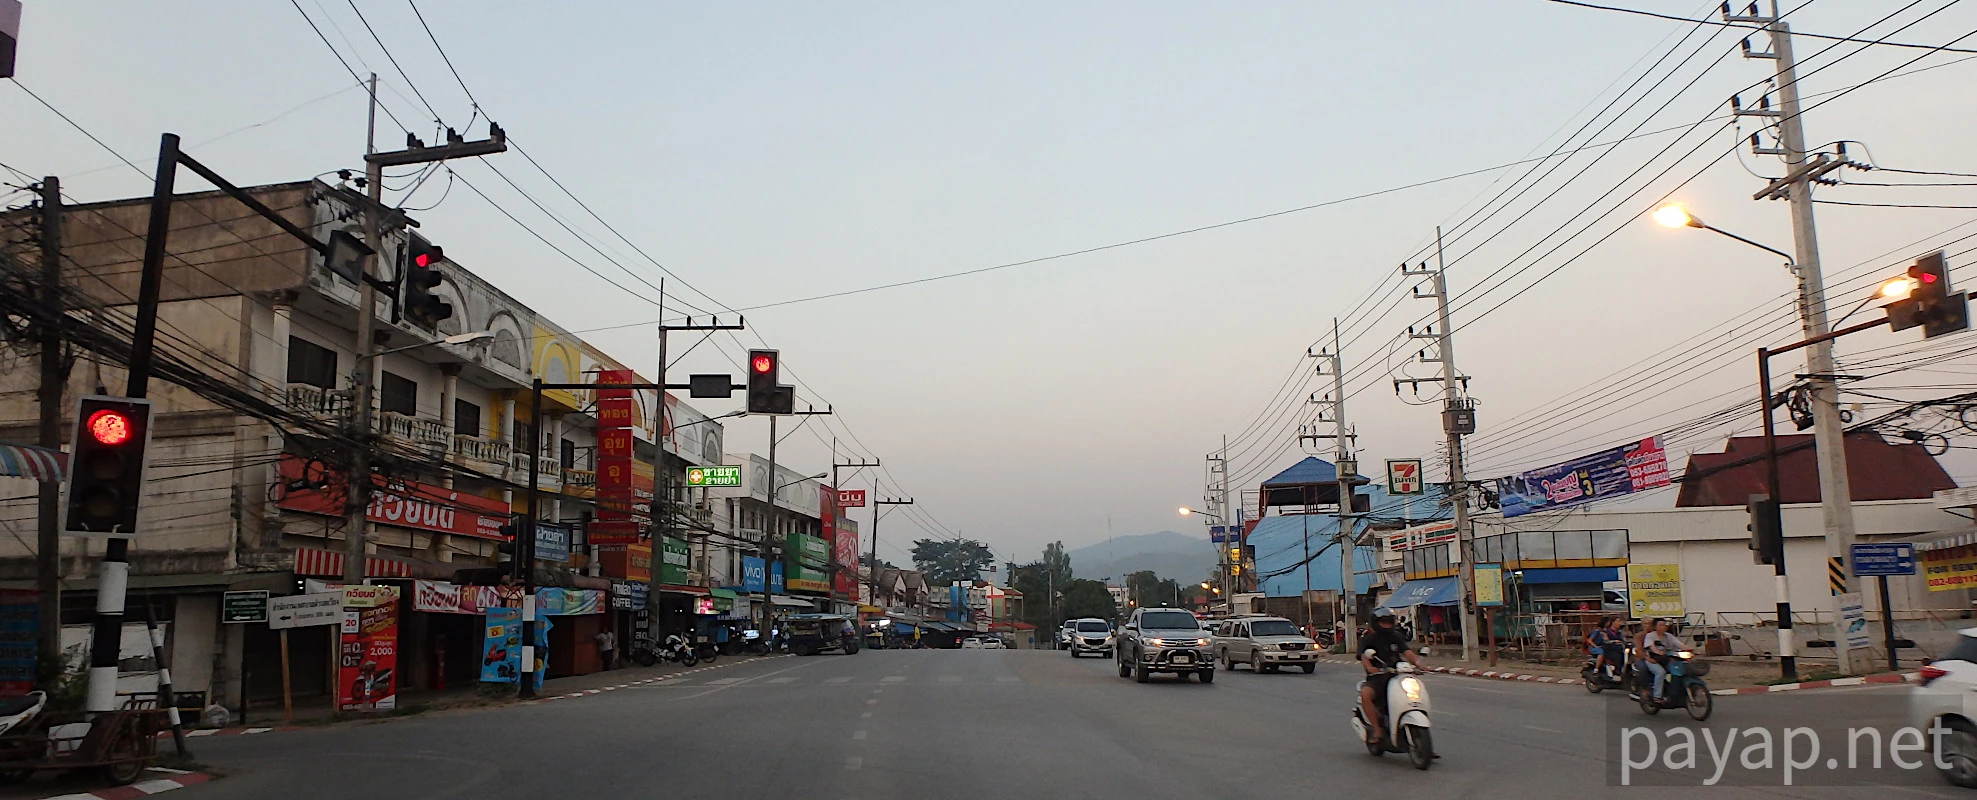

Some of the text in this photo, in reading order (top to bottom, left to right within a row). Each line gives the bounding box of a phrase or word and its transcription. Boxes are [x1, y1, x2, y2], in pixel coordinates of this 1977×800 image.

[601, 408, 628, 419] ทอง
[1393, 463, 1415, 491] 7
[1582, 479, 1593, 496] 3
[744, 564, 760, 578] vivo
[1927, 565, 1948, 575] FOR
[1411, 585, 1434, 596] vivo
[612, 597, 631, 608] COFFEE
[345, 619, 357, 627] 20
